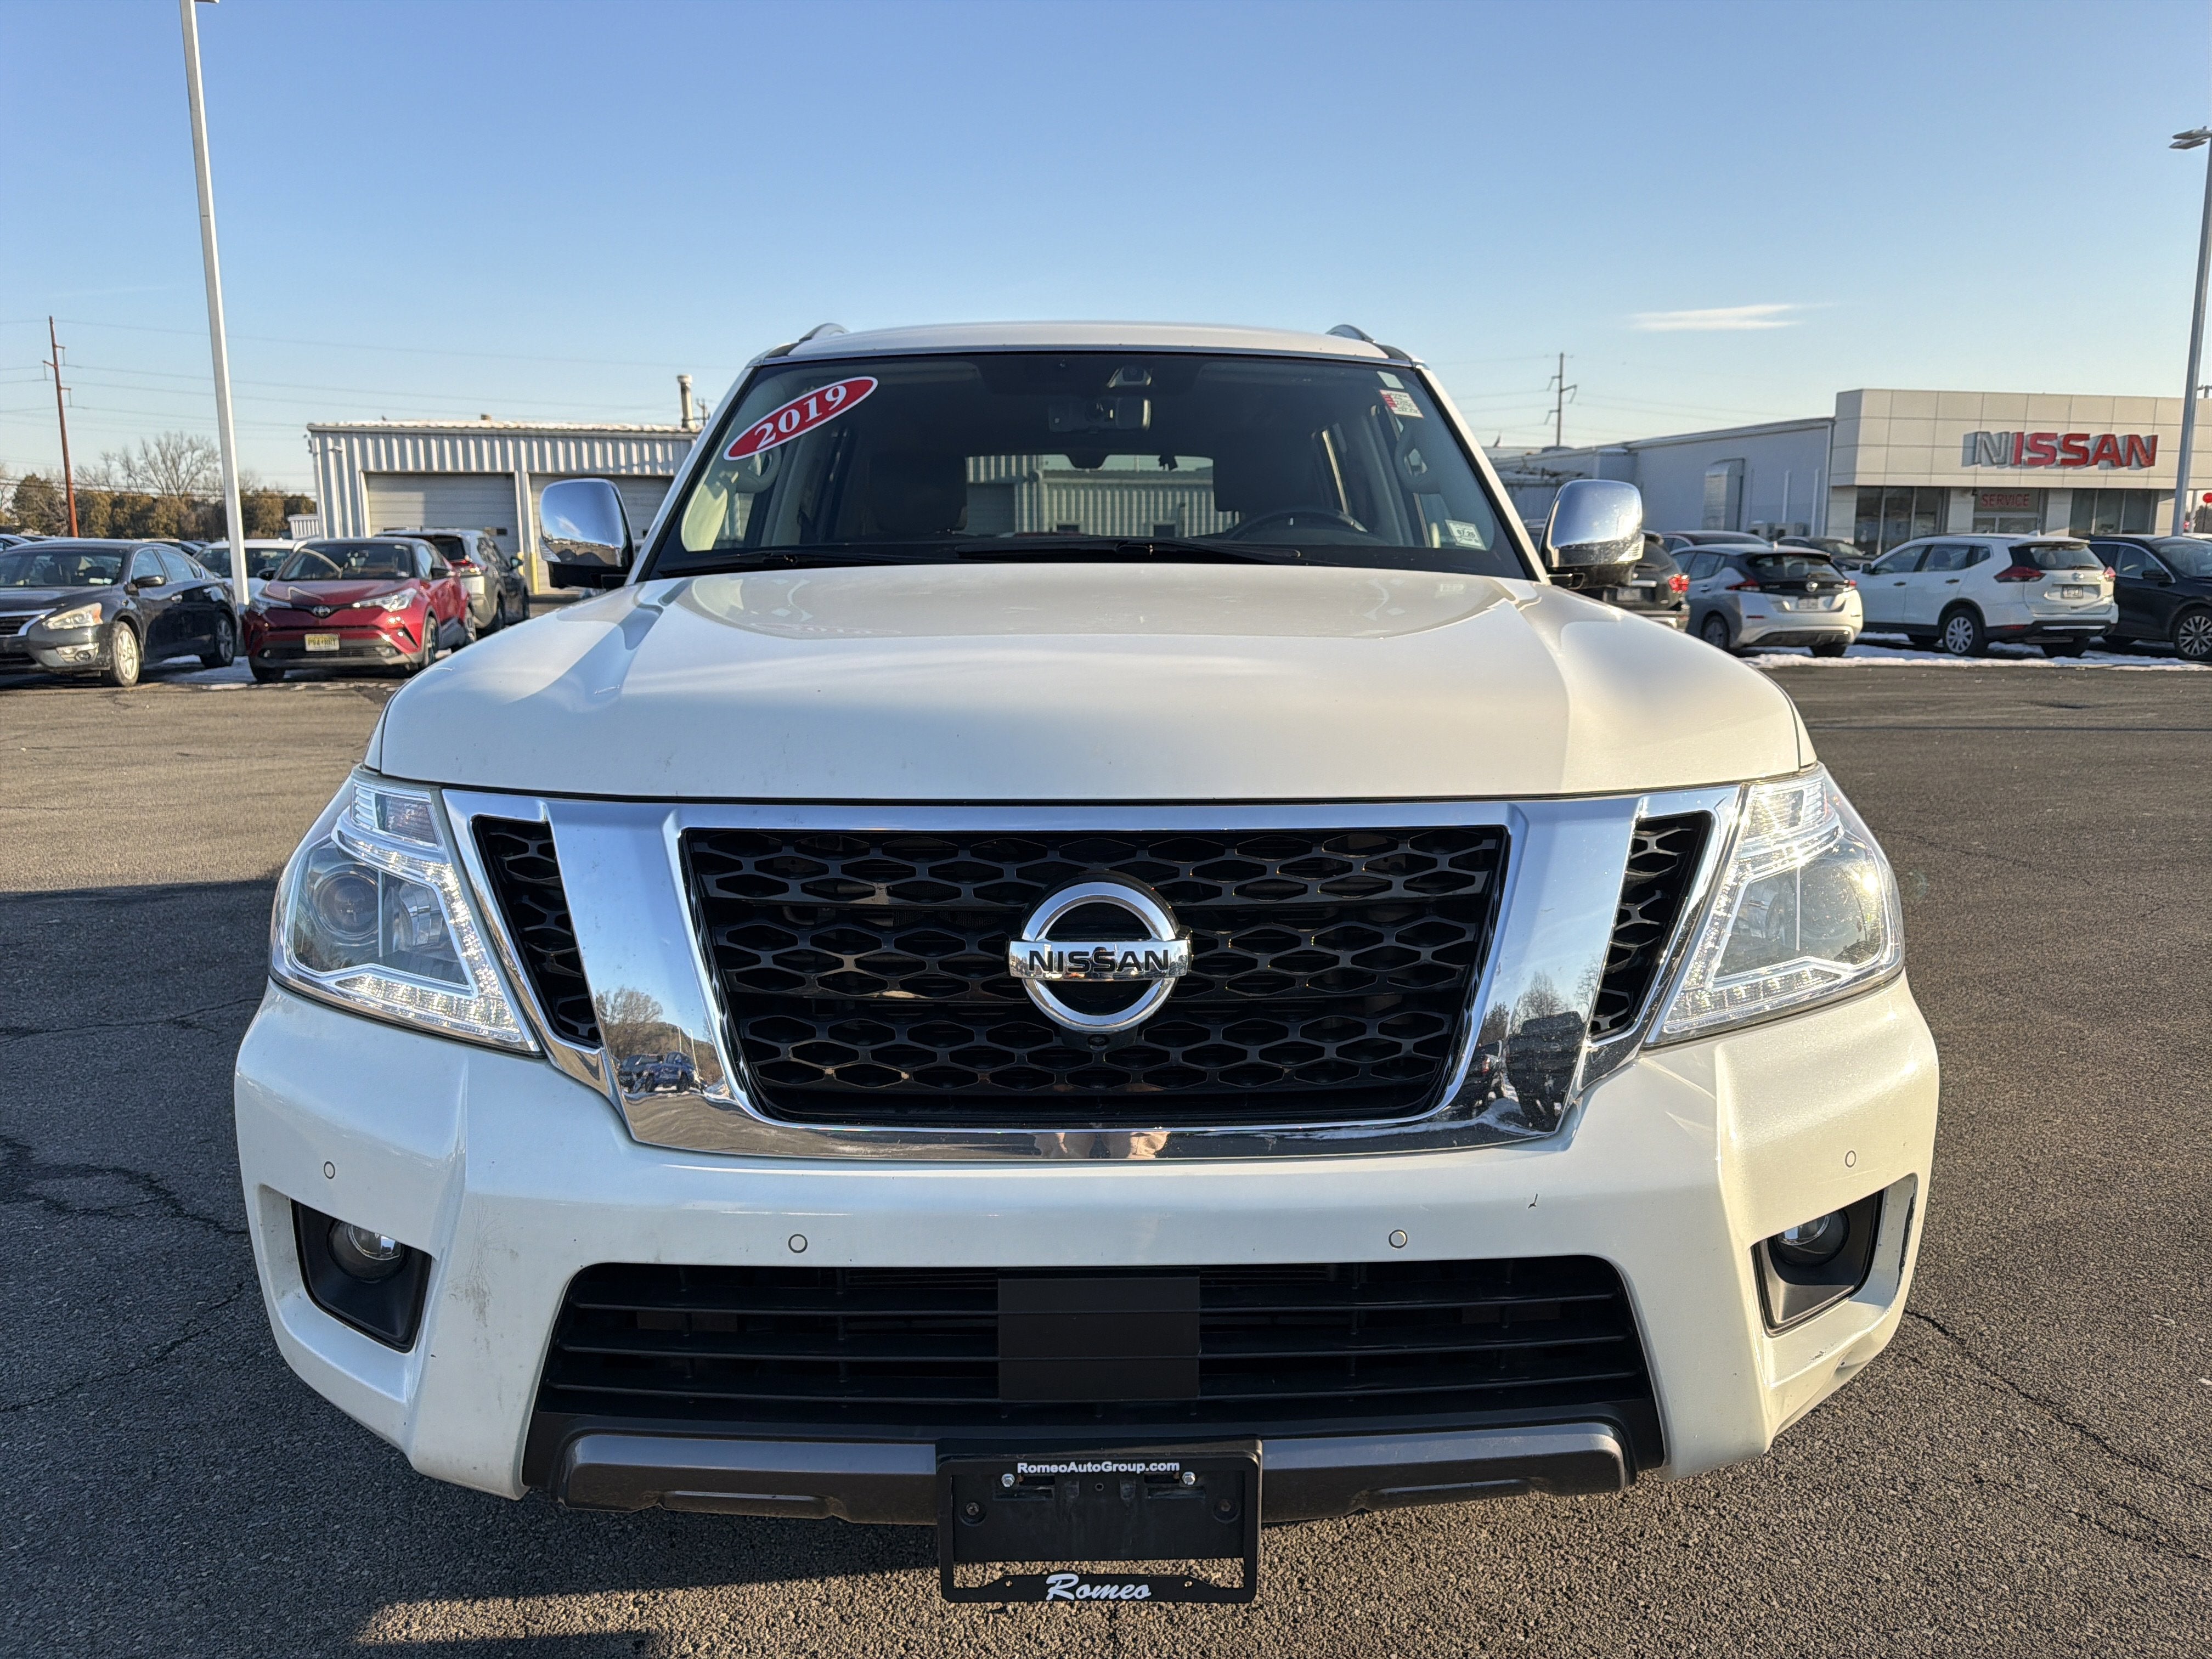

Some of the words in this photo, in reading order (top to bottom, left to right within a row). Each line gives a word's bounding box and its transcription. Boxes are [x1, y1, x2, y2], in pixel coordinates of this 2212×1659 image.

[754, 385, 847, 450] 2019
[1974, 431, 2158, 467] NISSAN
[1981, 493, 2030, 507] SERVICE
[1029, 949, 1169, 972] NISSAN
[1017, 1462, 1180, 1474] RomeoAutoGroup.com
[1046, 1573, 1152, 1601] Romeo
